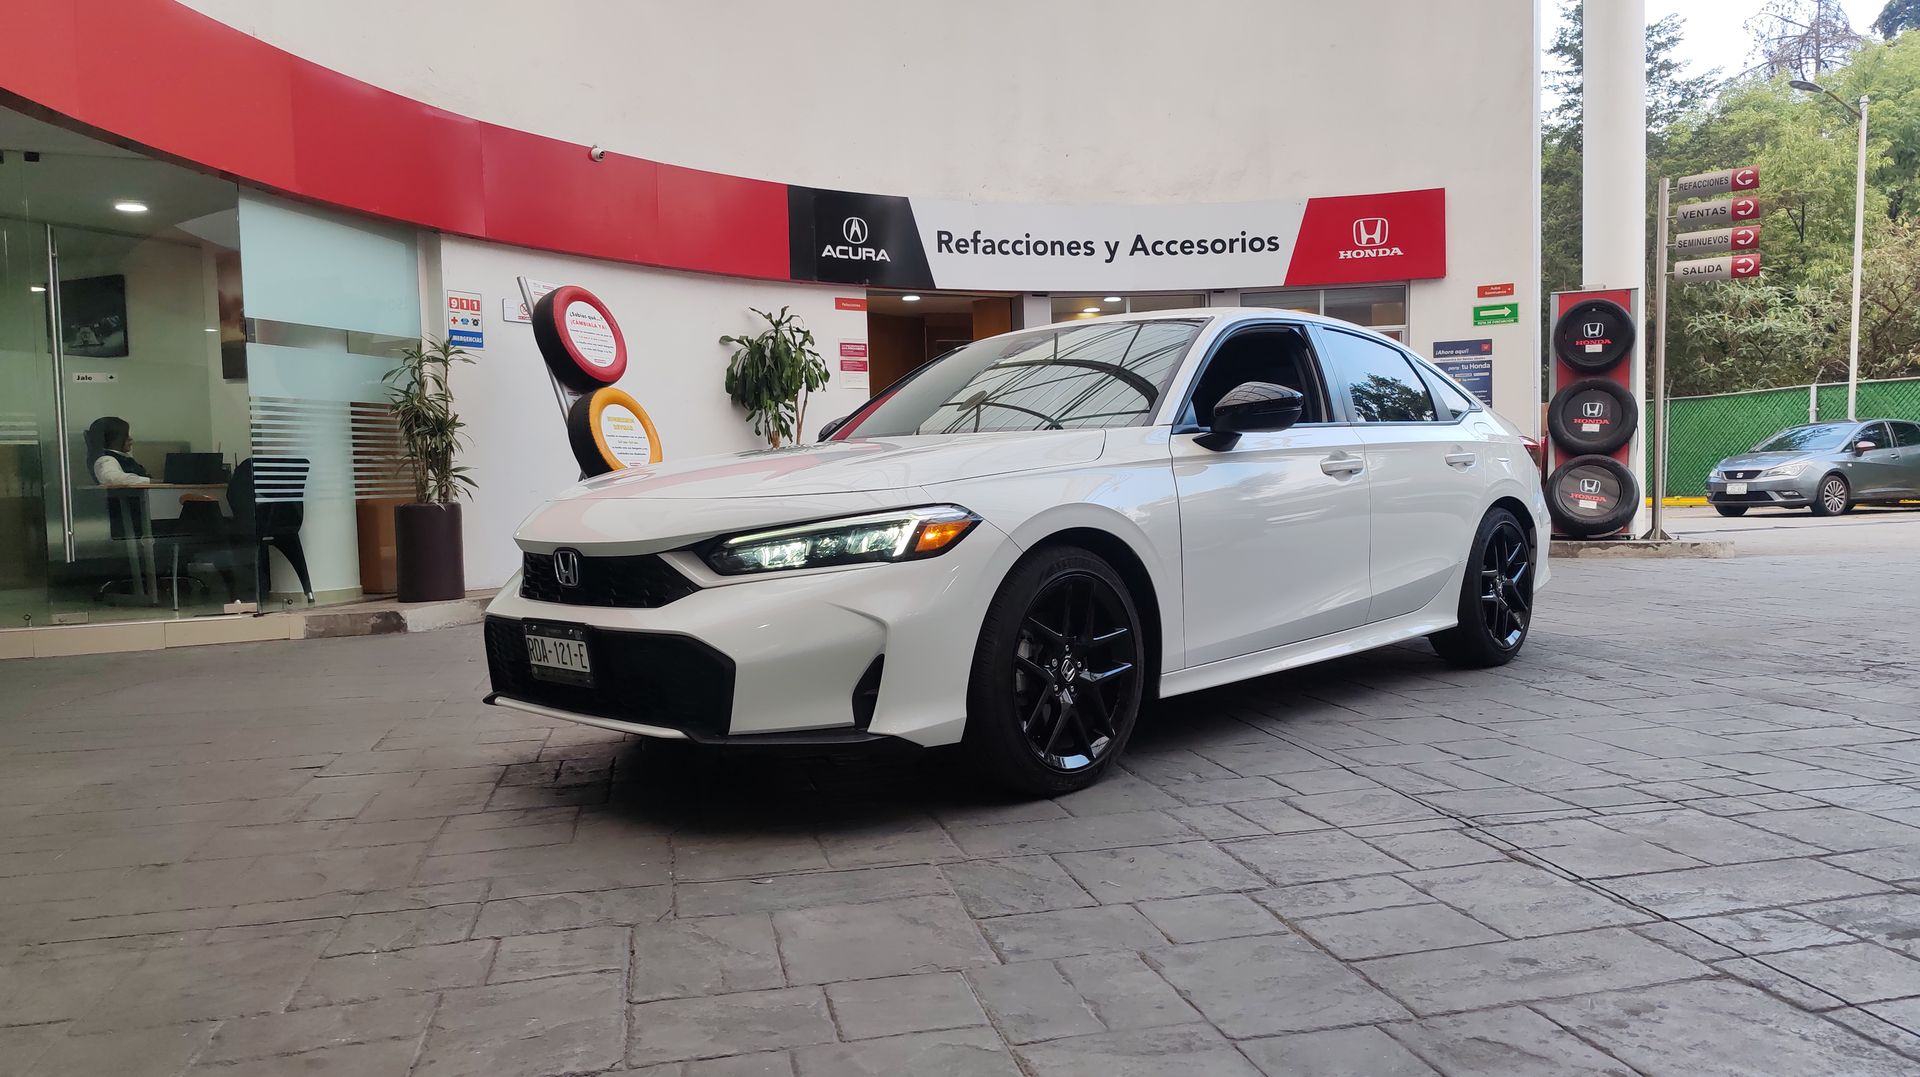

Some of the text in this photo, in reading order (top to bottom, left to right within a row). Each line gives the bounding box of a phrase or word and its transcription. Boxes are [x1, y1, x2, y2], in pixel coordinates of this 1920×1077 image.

[1678, 176, 1729, 191] REFACCIONES
[1682, 206, 1727, 220] VENTAS
[937, 230, 1280, 264] Refacciones y Accesorios
[1677, 235, 1729, 249] SEMINUEVOS
[821, 244, 891, 262] ACURA
[1338, 247, 1404, 260] HONDA
[1682, 264, 1723, 276] SALIDA
[450, 298, 479, 310] 911
[1575, 338, 1612, 346] HONDA
[1573, 417, 1610, 425] HONDA
[1569, 492, 1607, 503] HONDA
[527, 637, 588, 670] RDA-121-E
